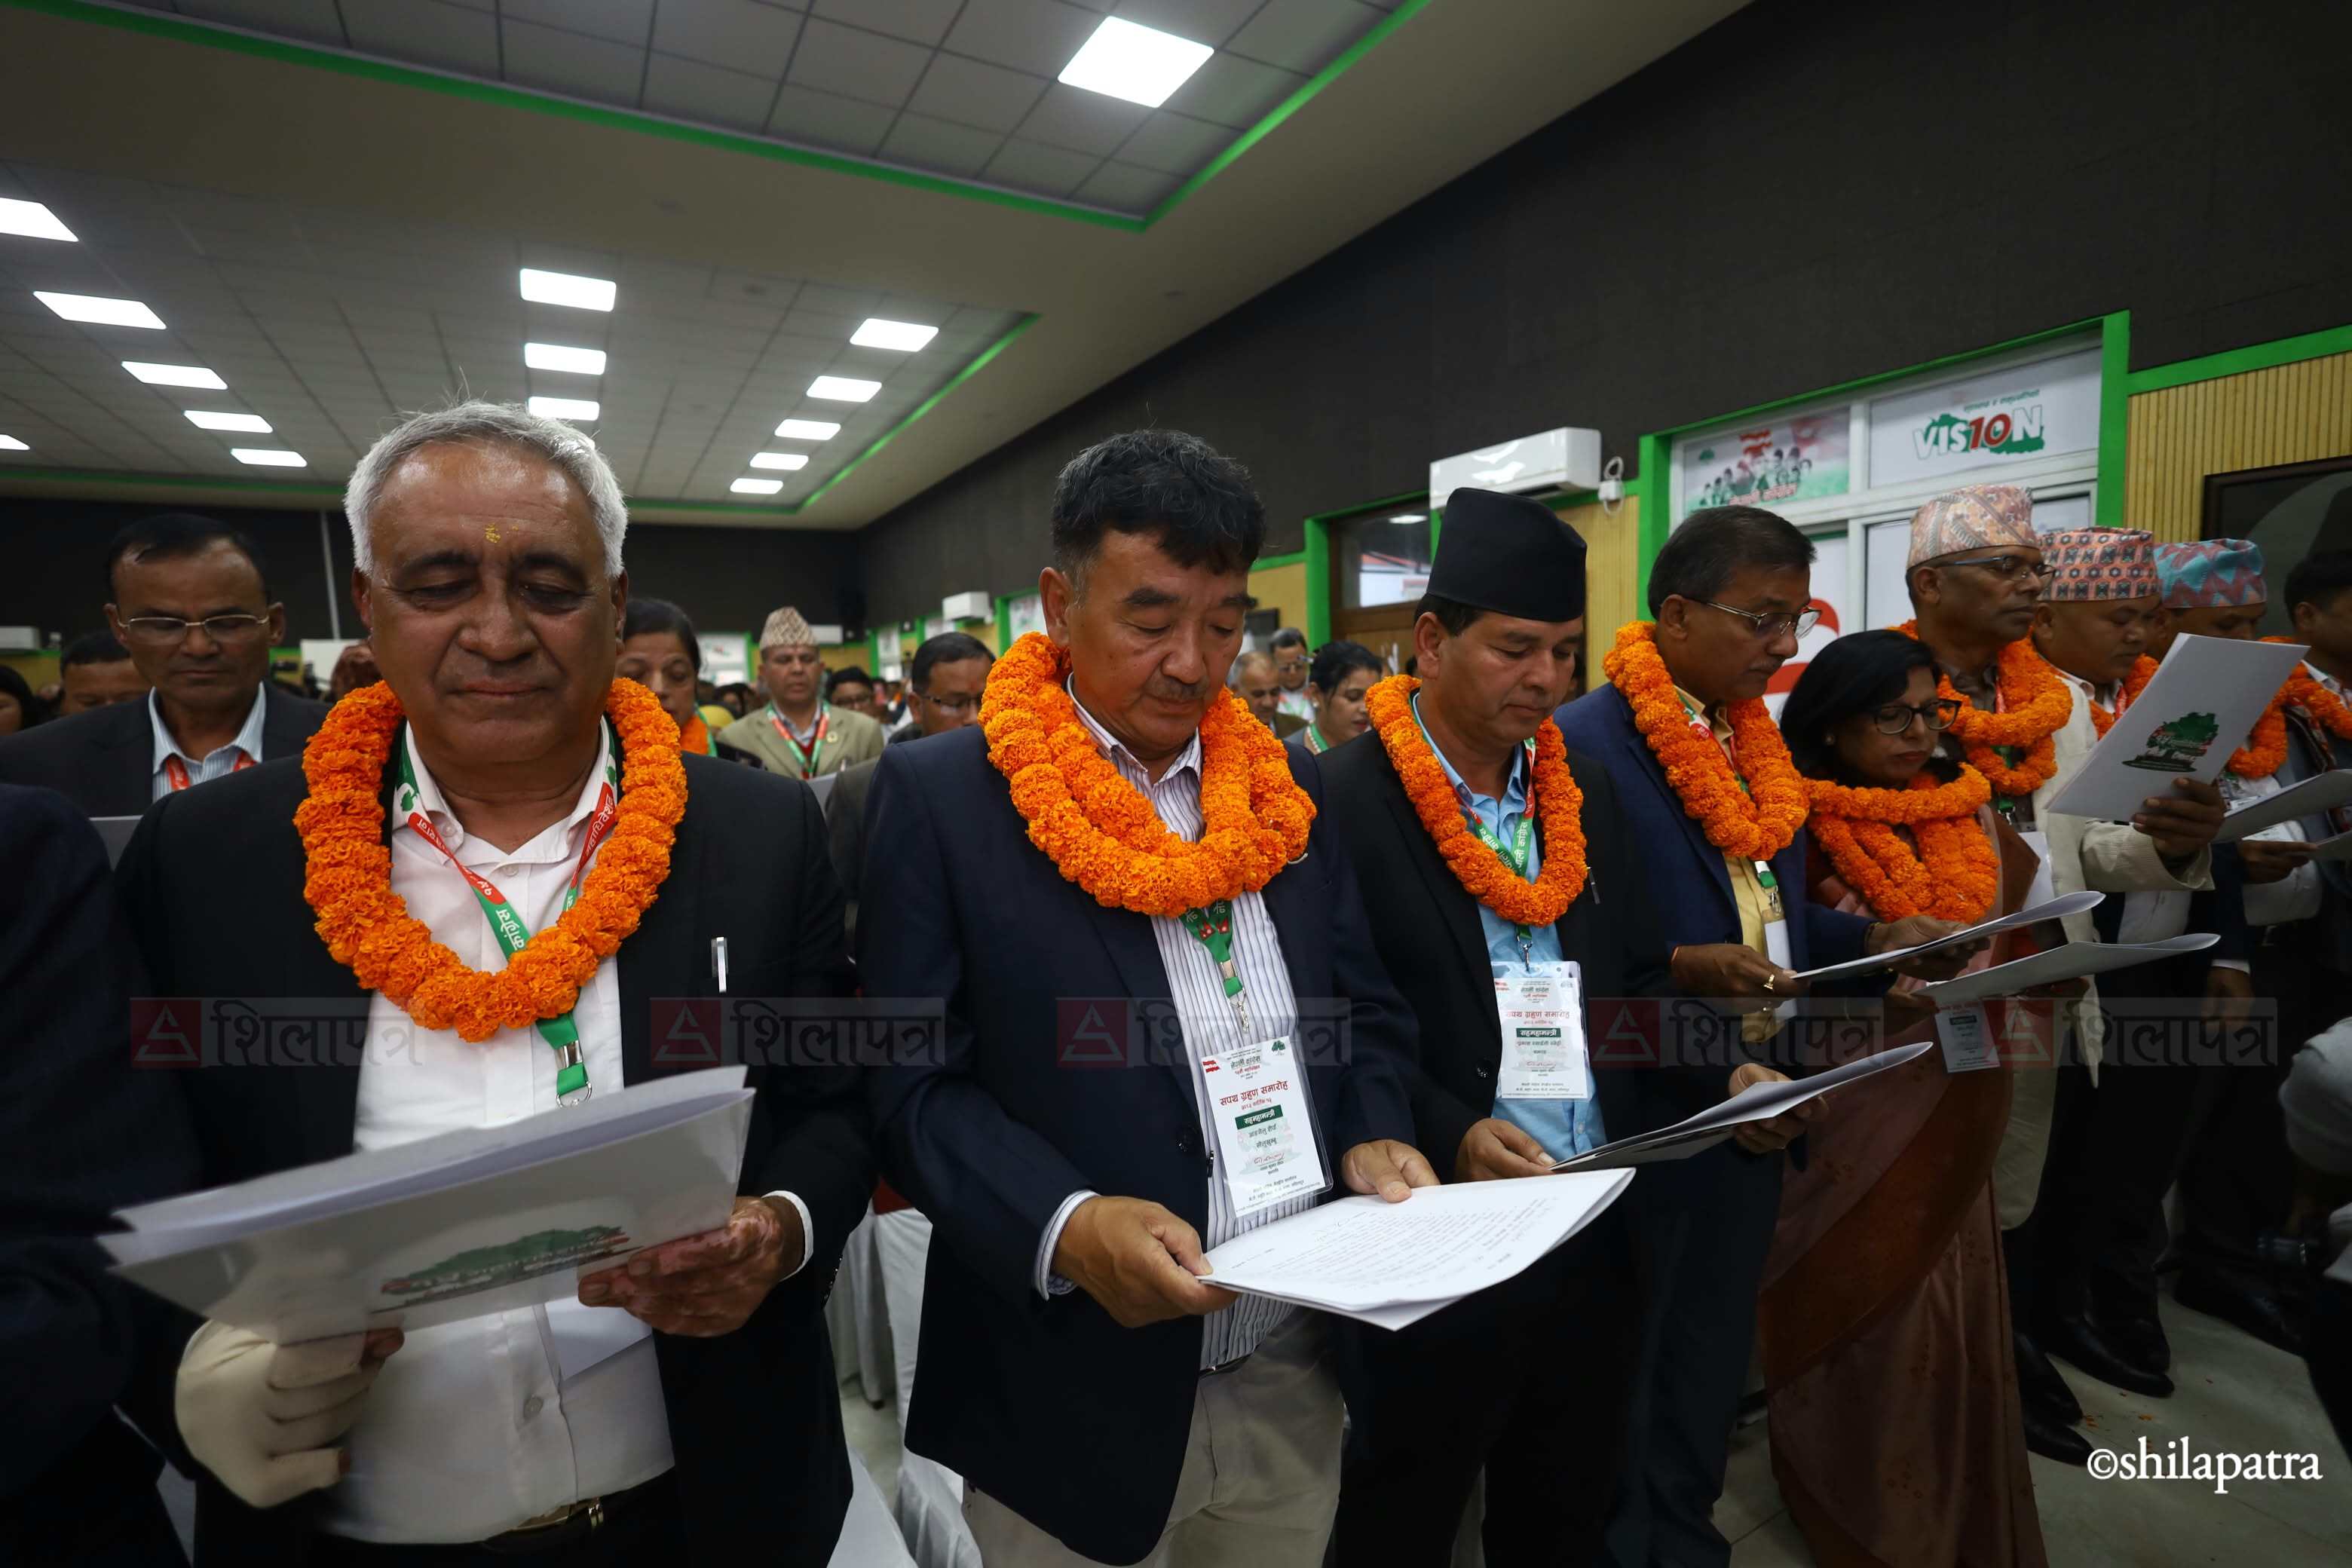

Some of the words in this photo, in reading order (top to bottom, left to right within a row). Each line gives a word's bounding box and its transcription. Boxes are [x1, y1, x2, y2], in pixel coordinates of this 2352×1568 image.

[1219, 1096, 1239, 1106] सपथ
[1241, 1089, 1258, 1101] ग्रहण
[1260, 1080, 1289, 1094] समारोह
